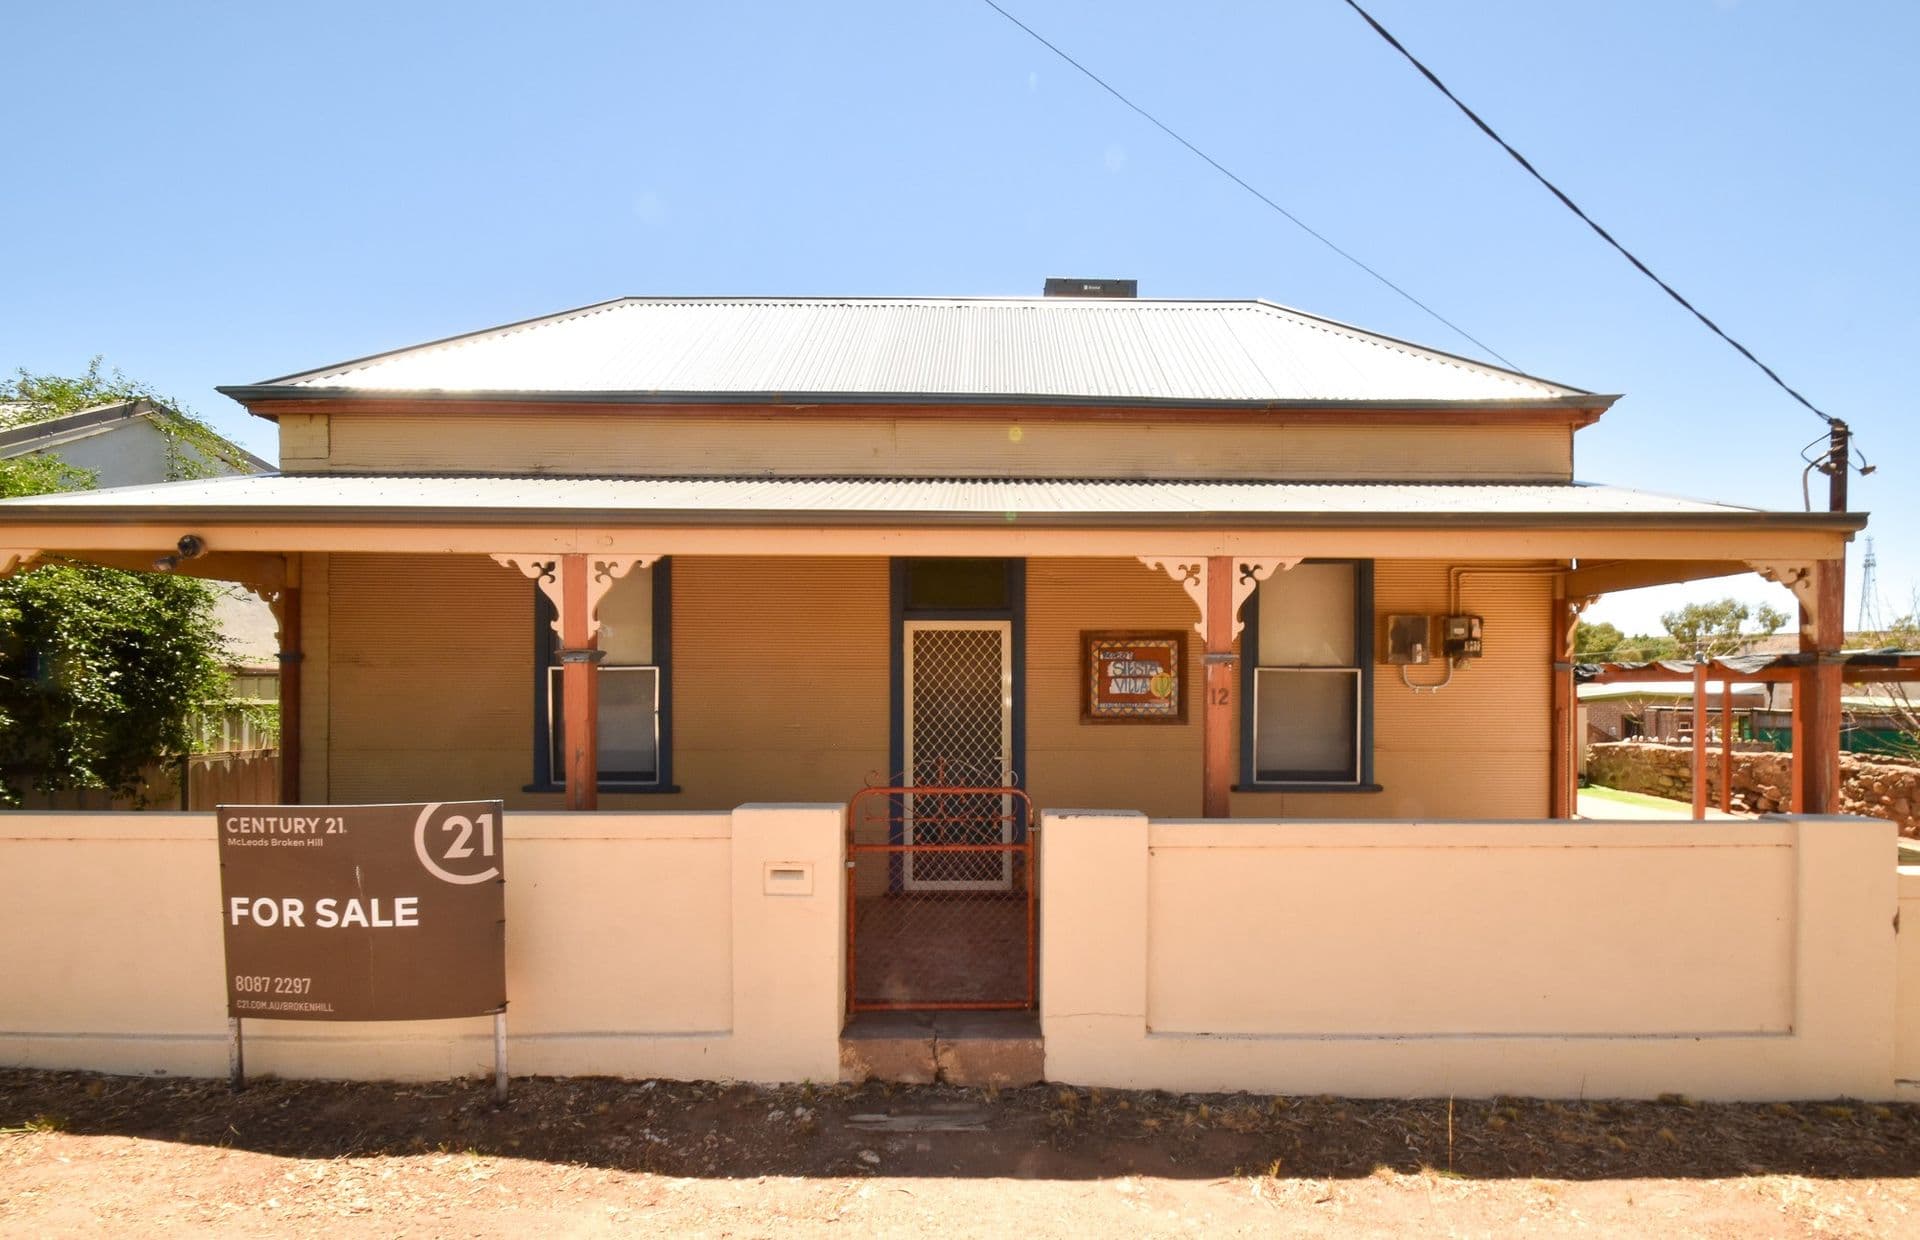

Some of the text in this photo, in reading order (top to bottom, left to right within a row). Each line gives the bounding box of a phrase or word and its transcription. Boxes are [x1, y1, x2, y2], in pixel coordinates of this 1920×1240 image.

[1112, 660, 1160, 677] SIESTA
[1113, 678, 1148, 694] VILLA
[1211, 688, 1229, 705] 12
[226, 818, 320, 834] CENTURY
[227, 838, 324, 847] McLeods Broken Hill
[230, 897, 419, 928] FOR SALE
[235, 976, 311, 994] 8087 2297
[236, 1000, 335, 1013] C21.COM.AU/BROKENHILL
